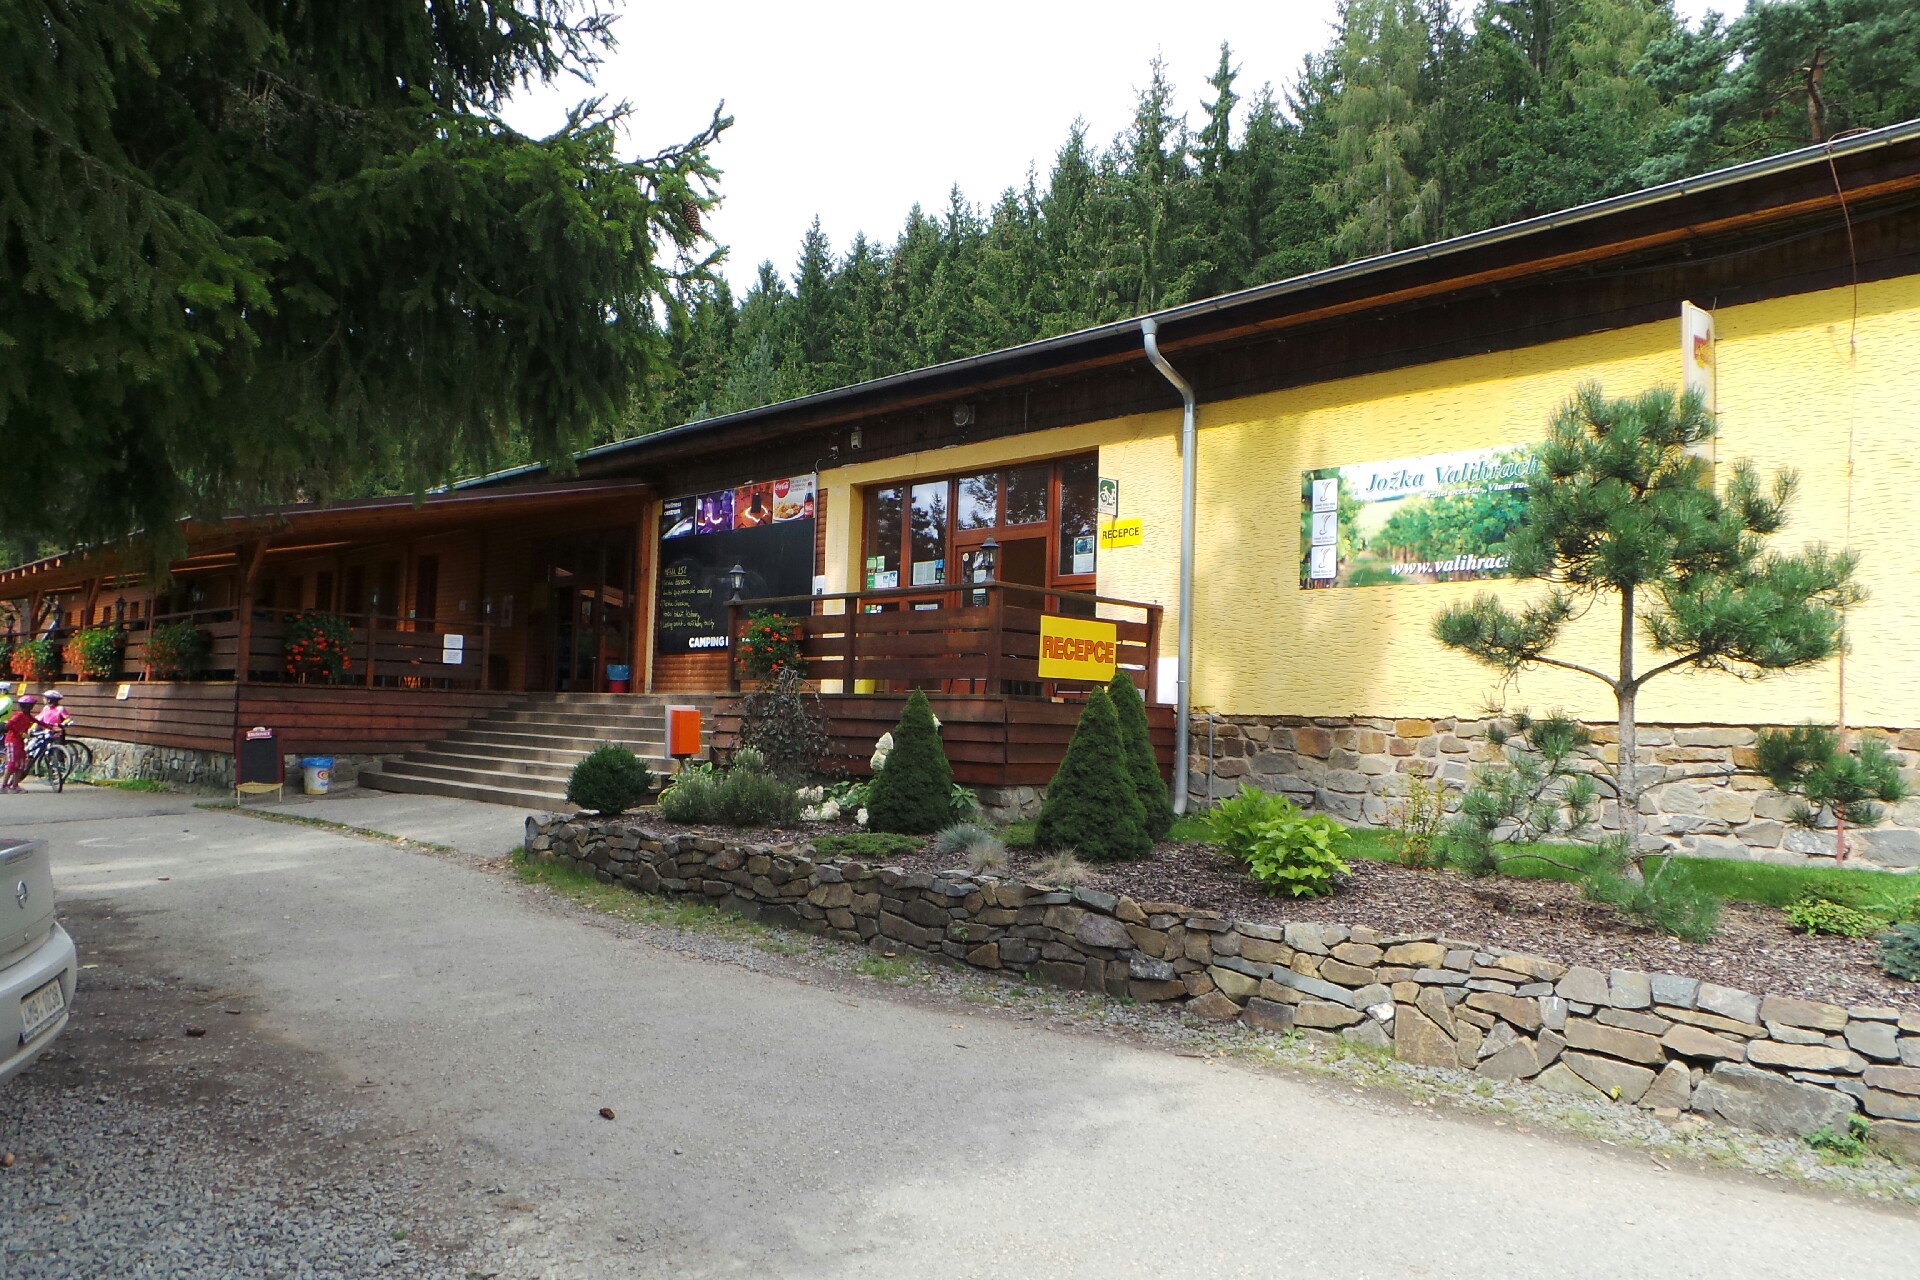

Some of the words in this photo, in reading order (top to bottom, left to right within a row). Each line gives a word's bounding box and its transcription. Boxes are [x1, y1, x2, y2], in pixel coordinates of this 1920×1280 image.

[1366, 469, 1425, 493] Jožka
[1435, 454, 1540, 485] Valihrach
[1102, 527, 1140, 540] RECEPCE
[688, 636, 725, 648] CAMPING
[1042, 635, 1115, 664] RECEPCE
